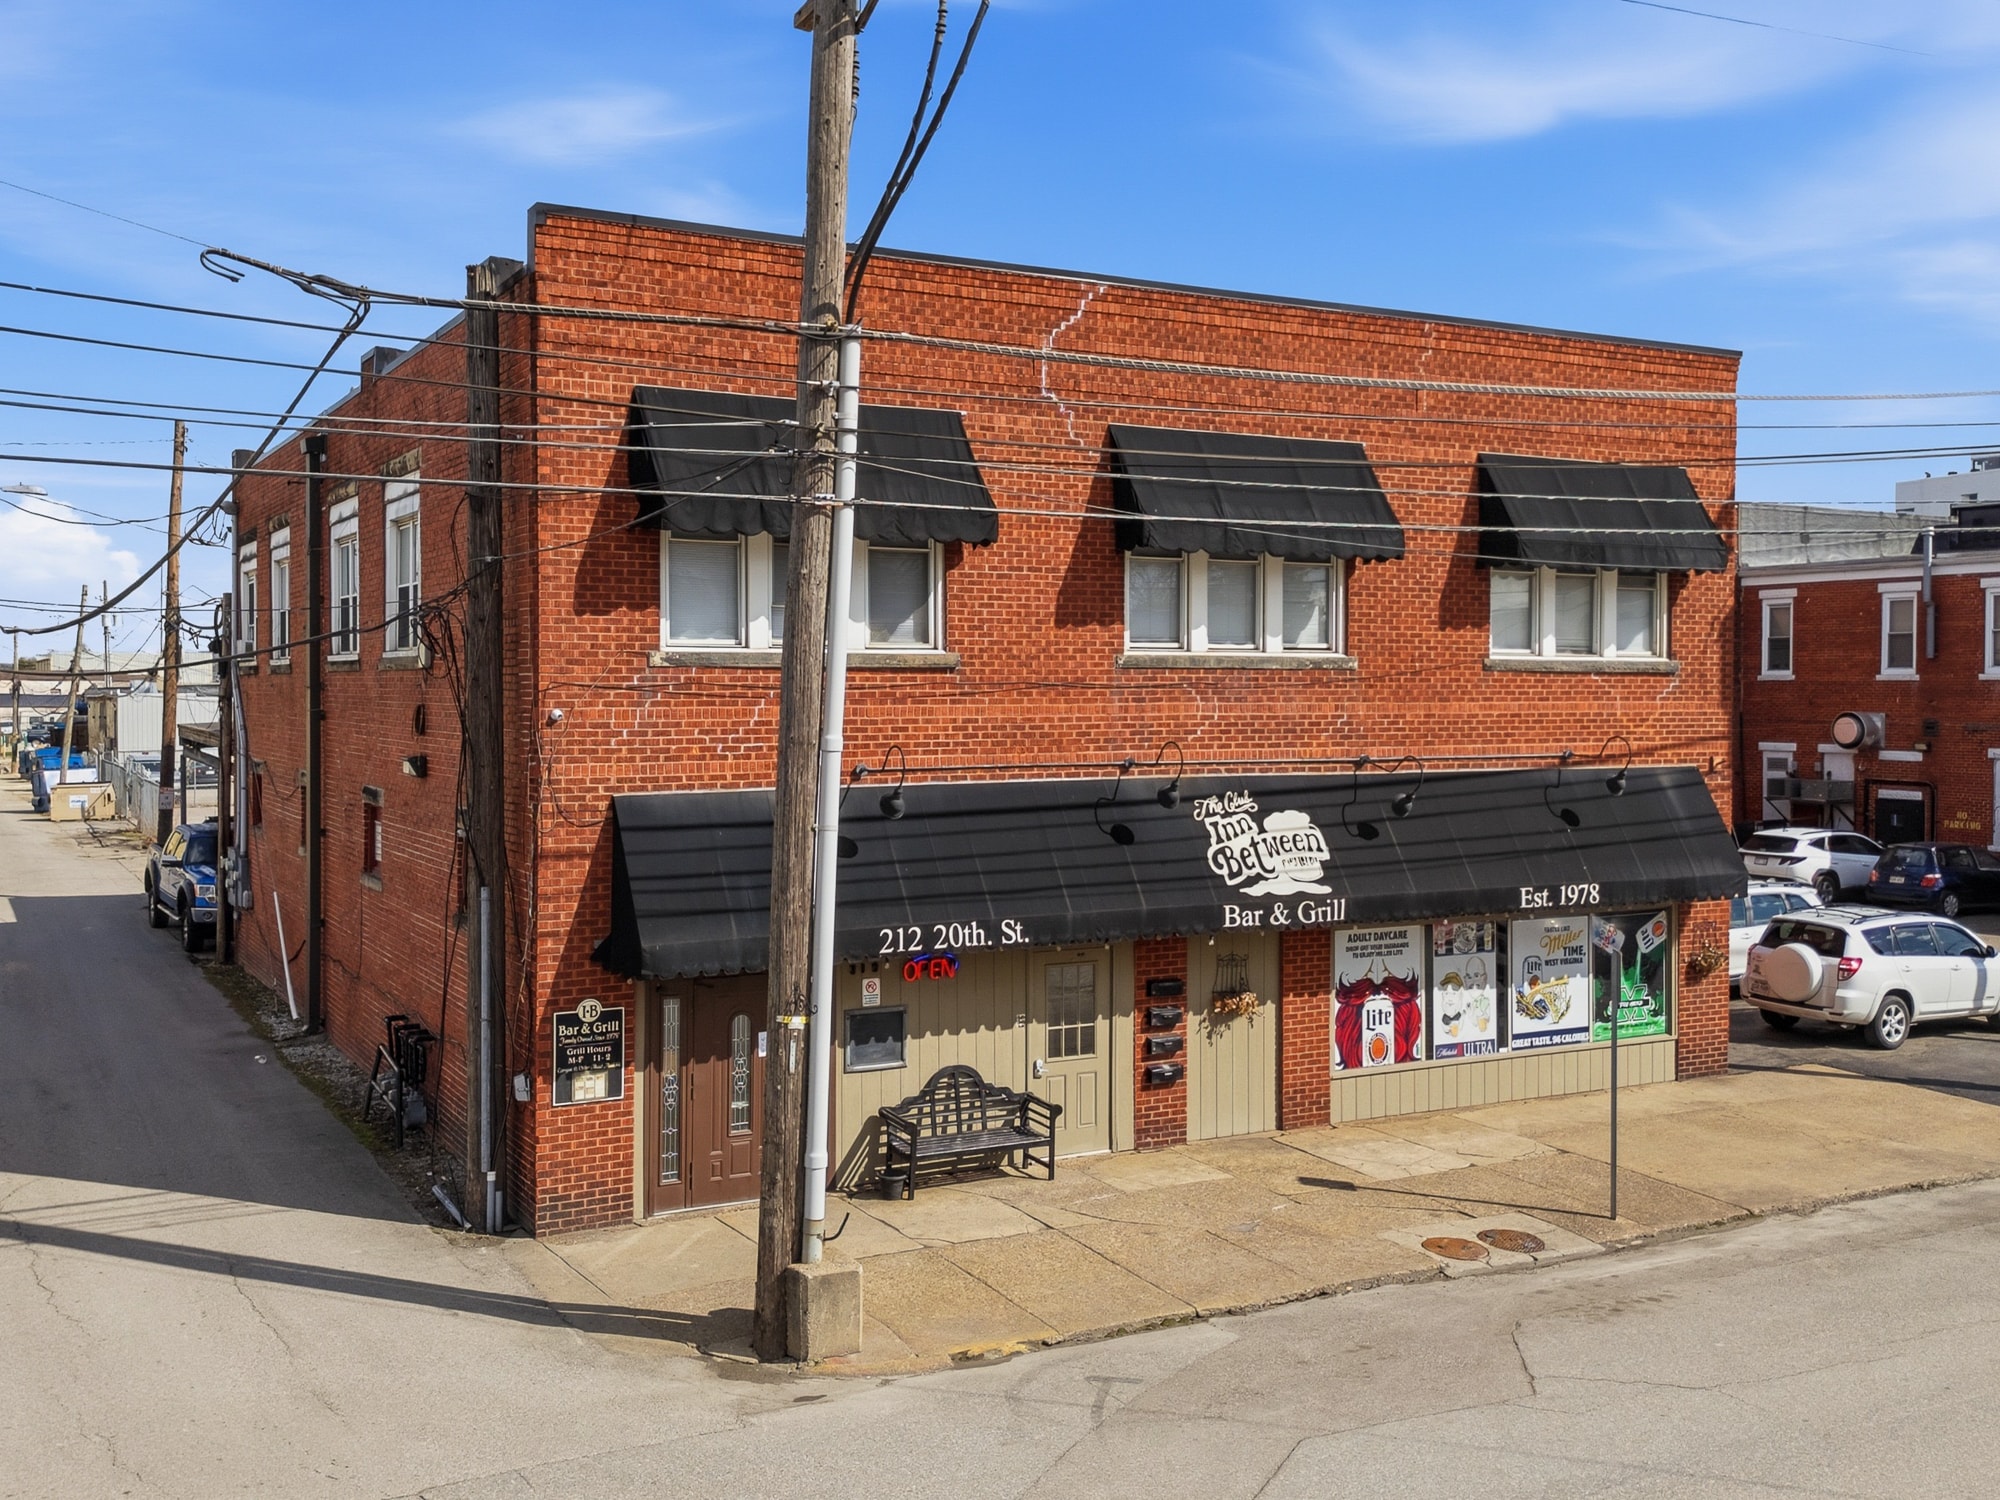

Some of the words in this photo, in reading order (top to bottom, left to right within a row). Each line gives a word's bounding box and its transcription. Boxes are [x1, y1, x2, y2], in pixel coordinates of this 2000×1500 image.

[1193, 795, 1225, 821] The
[1956, 811, 1969, 820] NO
[1208, 816, 1254, 845] Inn
[1943, 820, 1981, 830] PARKING
[1211, 831, 1325, 881] Between
[1519, 887, 1553, 909] Est.
[1559, 883, 1600, 906] 1978
[1222, 904, 1264, 928] Bar
[1269, 902, 1292, 926] &
[1297, 898, 1346, 924] Grill
[879, 926, 923, 954] 212
[933, 921, 993, 949] 20th.
[1001, 919, 1030, 944] St.
[1347, 932, 1372, 943] ADULT
[1373, 930, 1408, 941] DAYCARE
[1540, 929, 1584, 957] Miller
[1563, 945, 1587, 957] TIME,
[558, 1025, 579, 1036] Bar
[581, 1023, 590, 1034] &
[593, 1021, 619, 1033] Grill
[1366, 1009, 1391, 1031] Lite
[1463, 1041, 1493, 1056] ULTRA
[1511, 1038, 1531, 1048] GREAT
[1562, 1032, 1589, 1043] CALORIES
[566, 1048, 585, 1056] Grill
[587, 1046, 612, 1054] Hours
